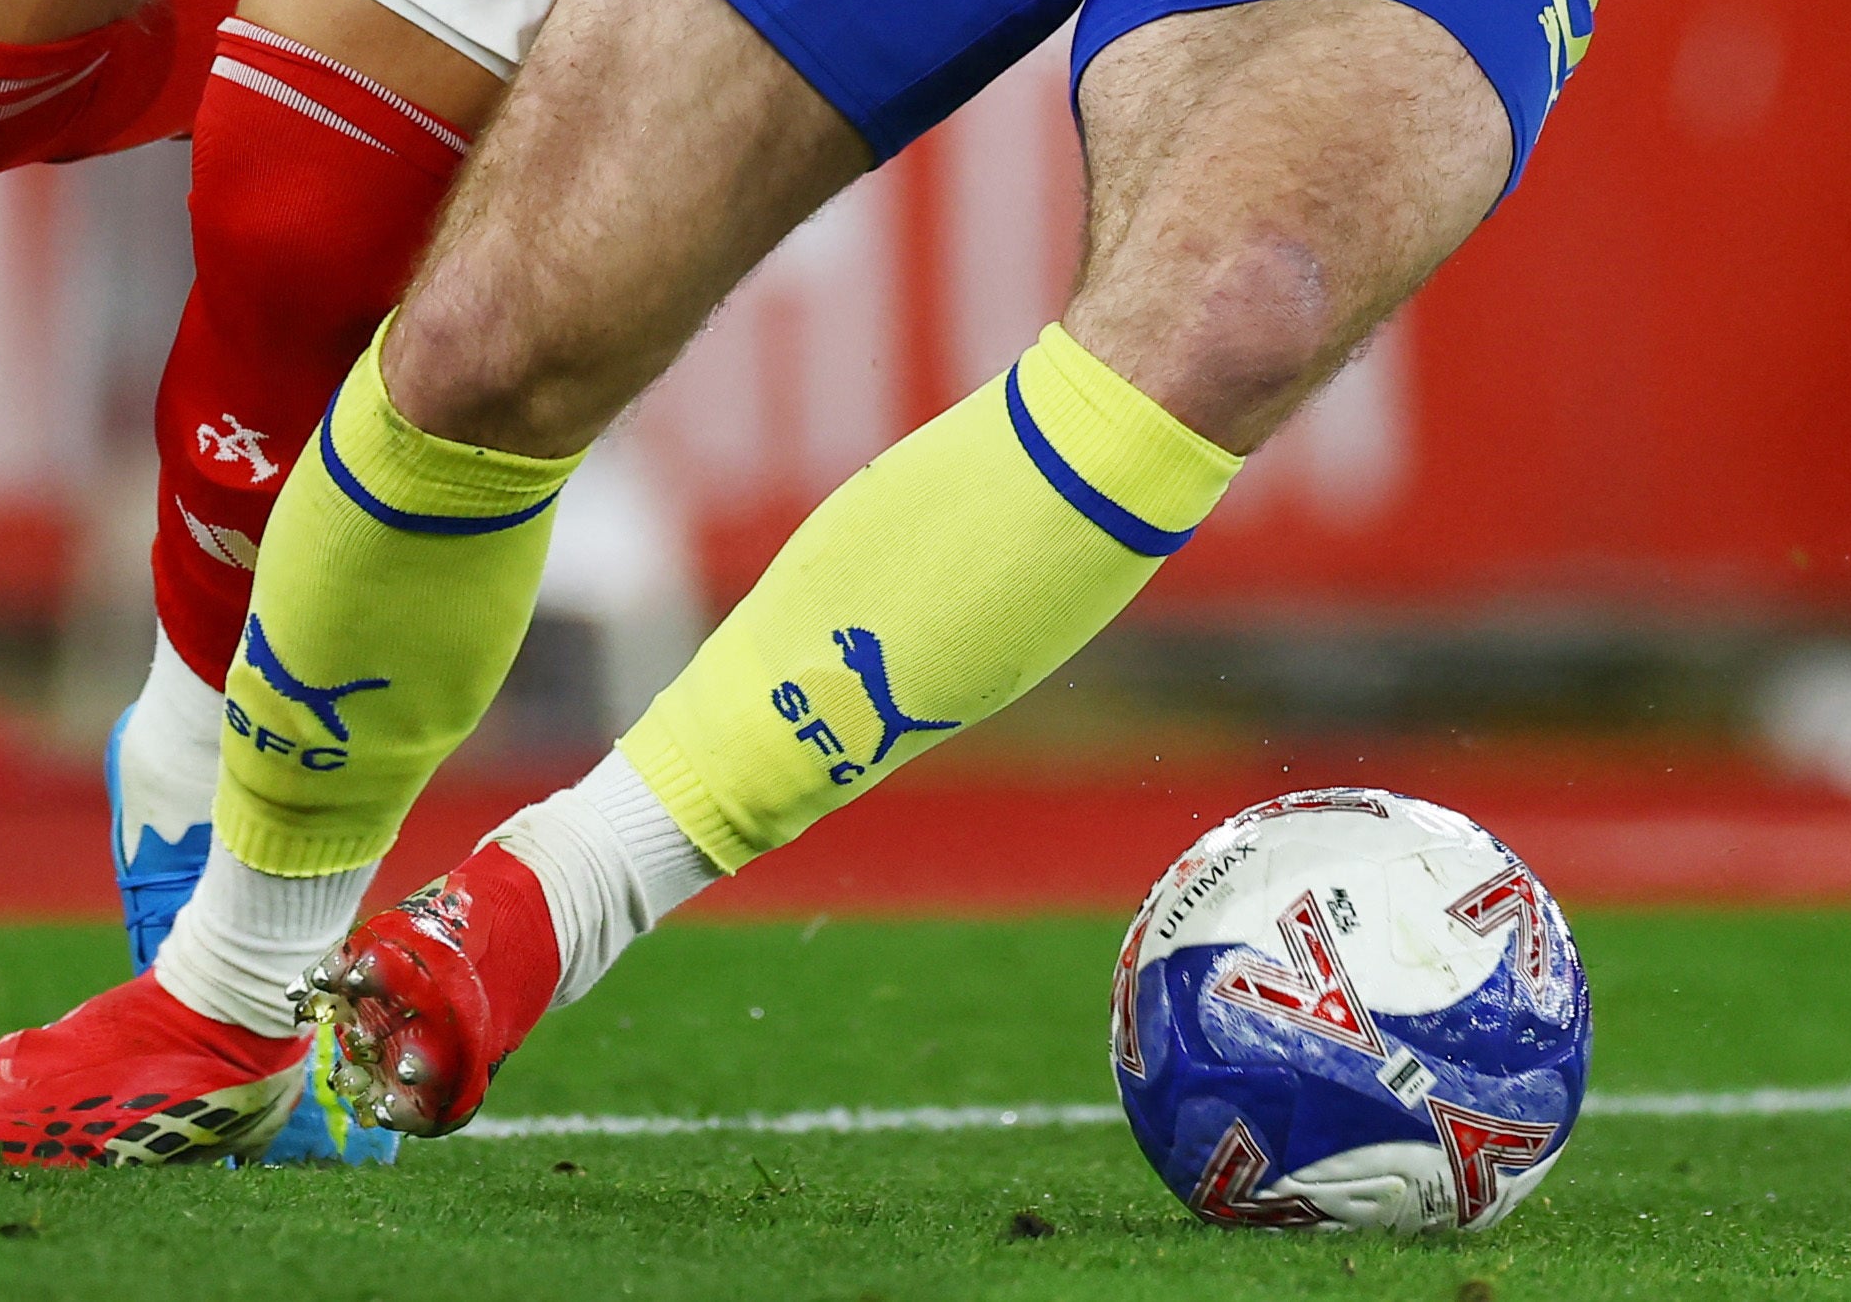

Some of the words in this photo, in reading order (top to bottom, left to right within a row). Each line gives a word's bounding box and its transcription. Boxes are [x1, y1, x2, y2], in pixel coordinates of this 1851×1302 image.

[225, 698, 349, 771] SFC
[771, 680, 866, 786] SFC
[1158, 842, 1257, 940] ULTIMAX
